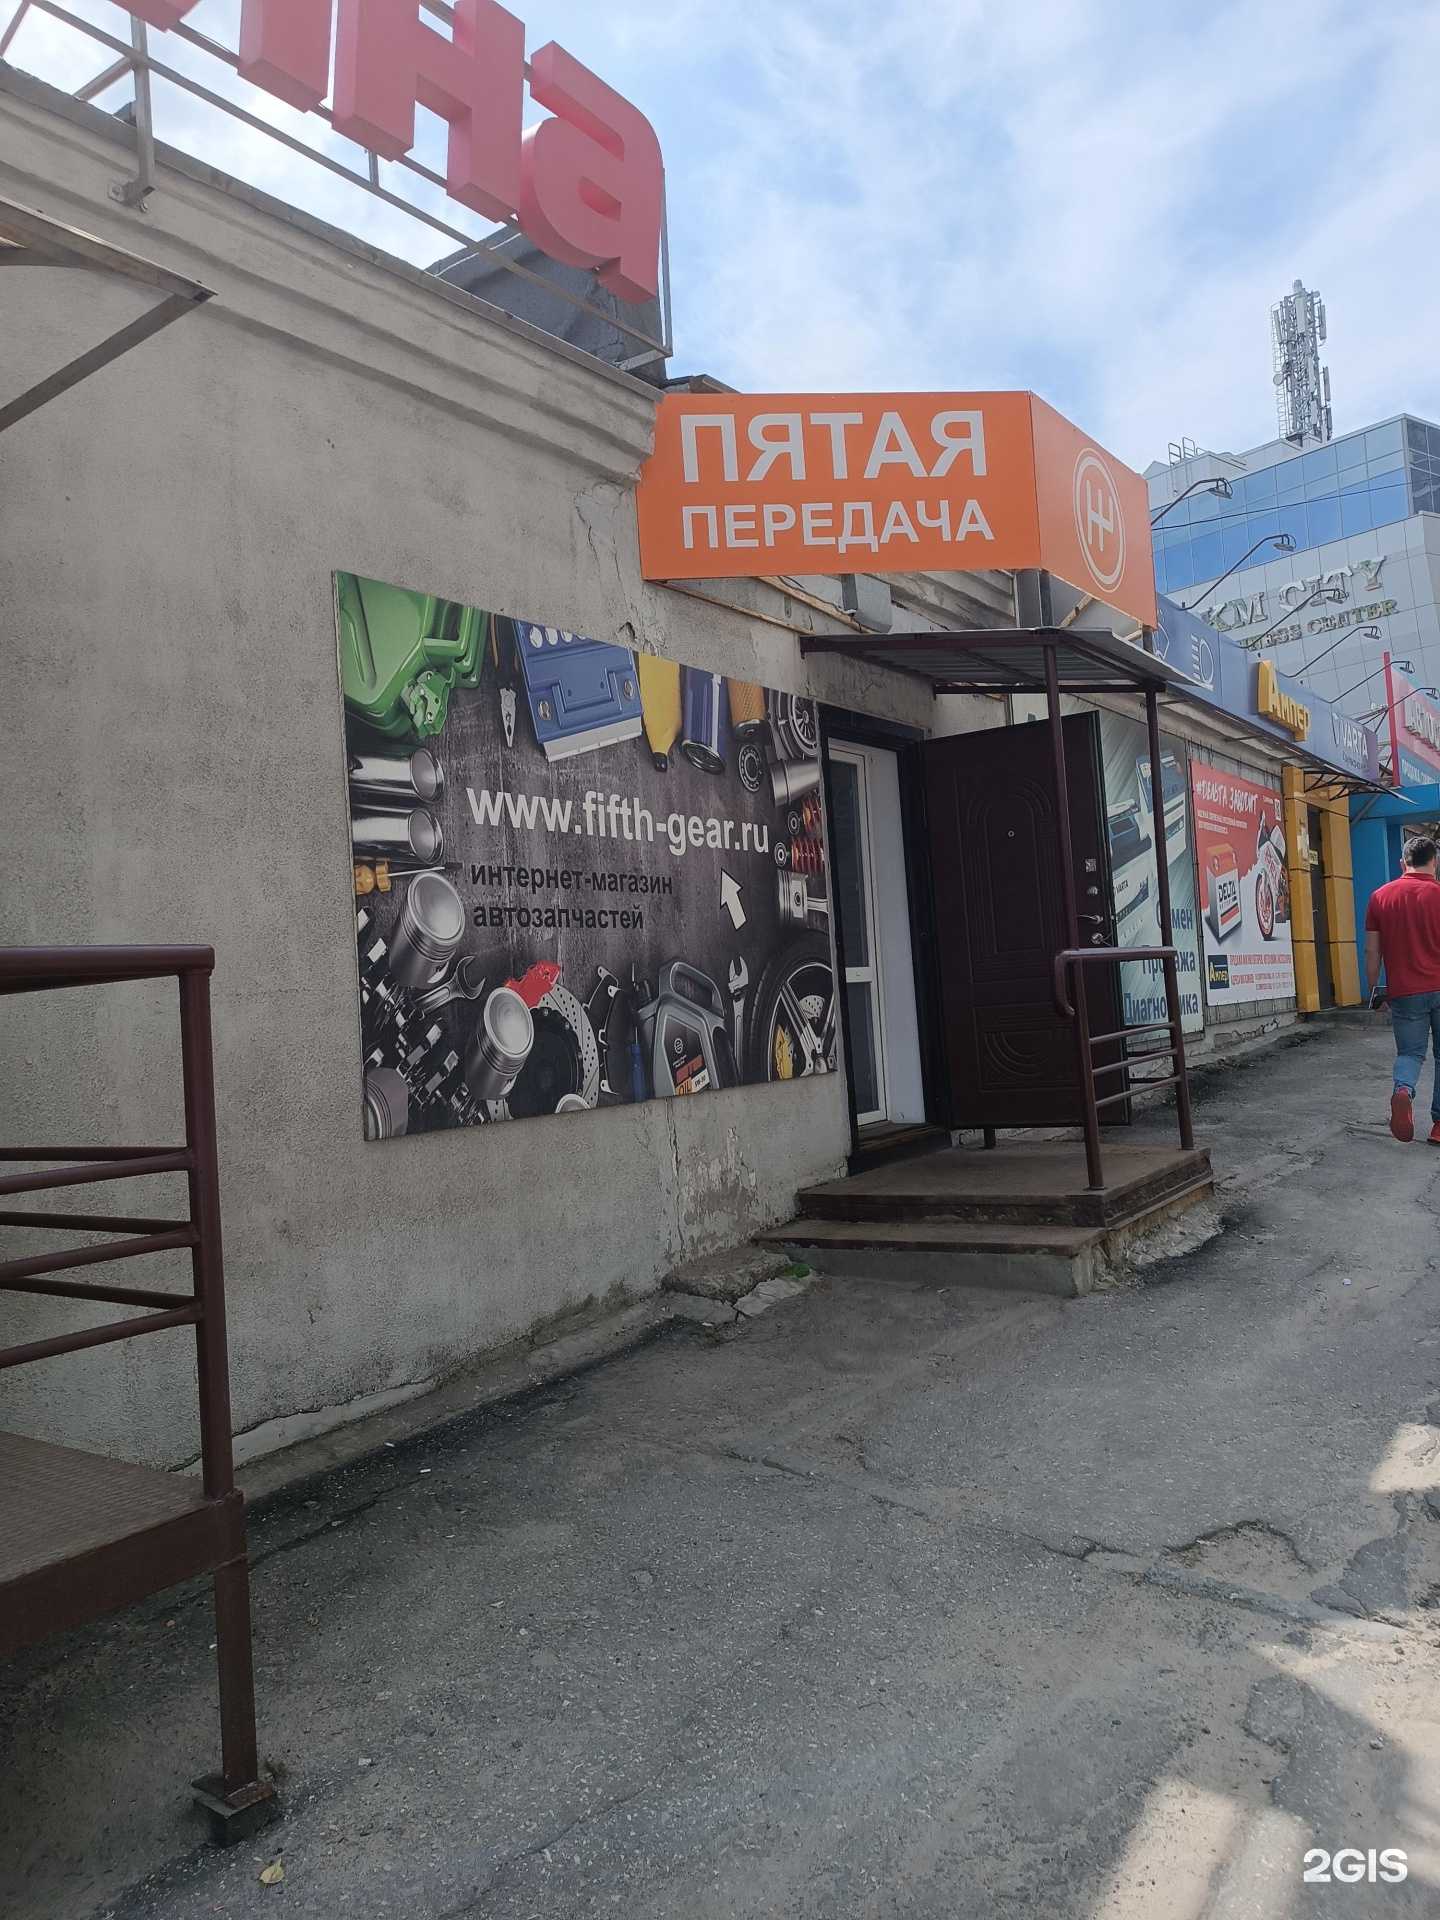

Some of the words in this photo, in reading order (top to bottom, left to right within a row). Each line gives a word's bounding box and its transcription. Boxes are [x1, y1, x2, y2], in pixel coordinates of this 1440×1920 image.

[679, 410, 988, 484] ПЯТАЯ
[682, 499, 995, 554] ПЕРЕДАЧА
[1307, 599, 1398, 635] CENTER
[465, 786, 770, 857] www.fifth-gear.ru
[470, 860, 674, 897] интернет-магазин
[472, 904, 645, 931] автозапчастей
[1123, 991, 1199, 1024] Диагноика
